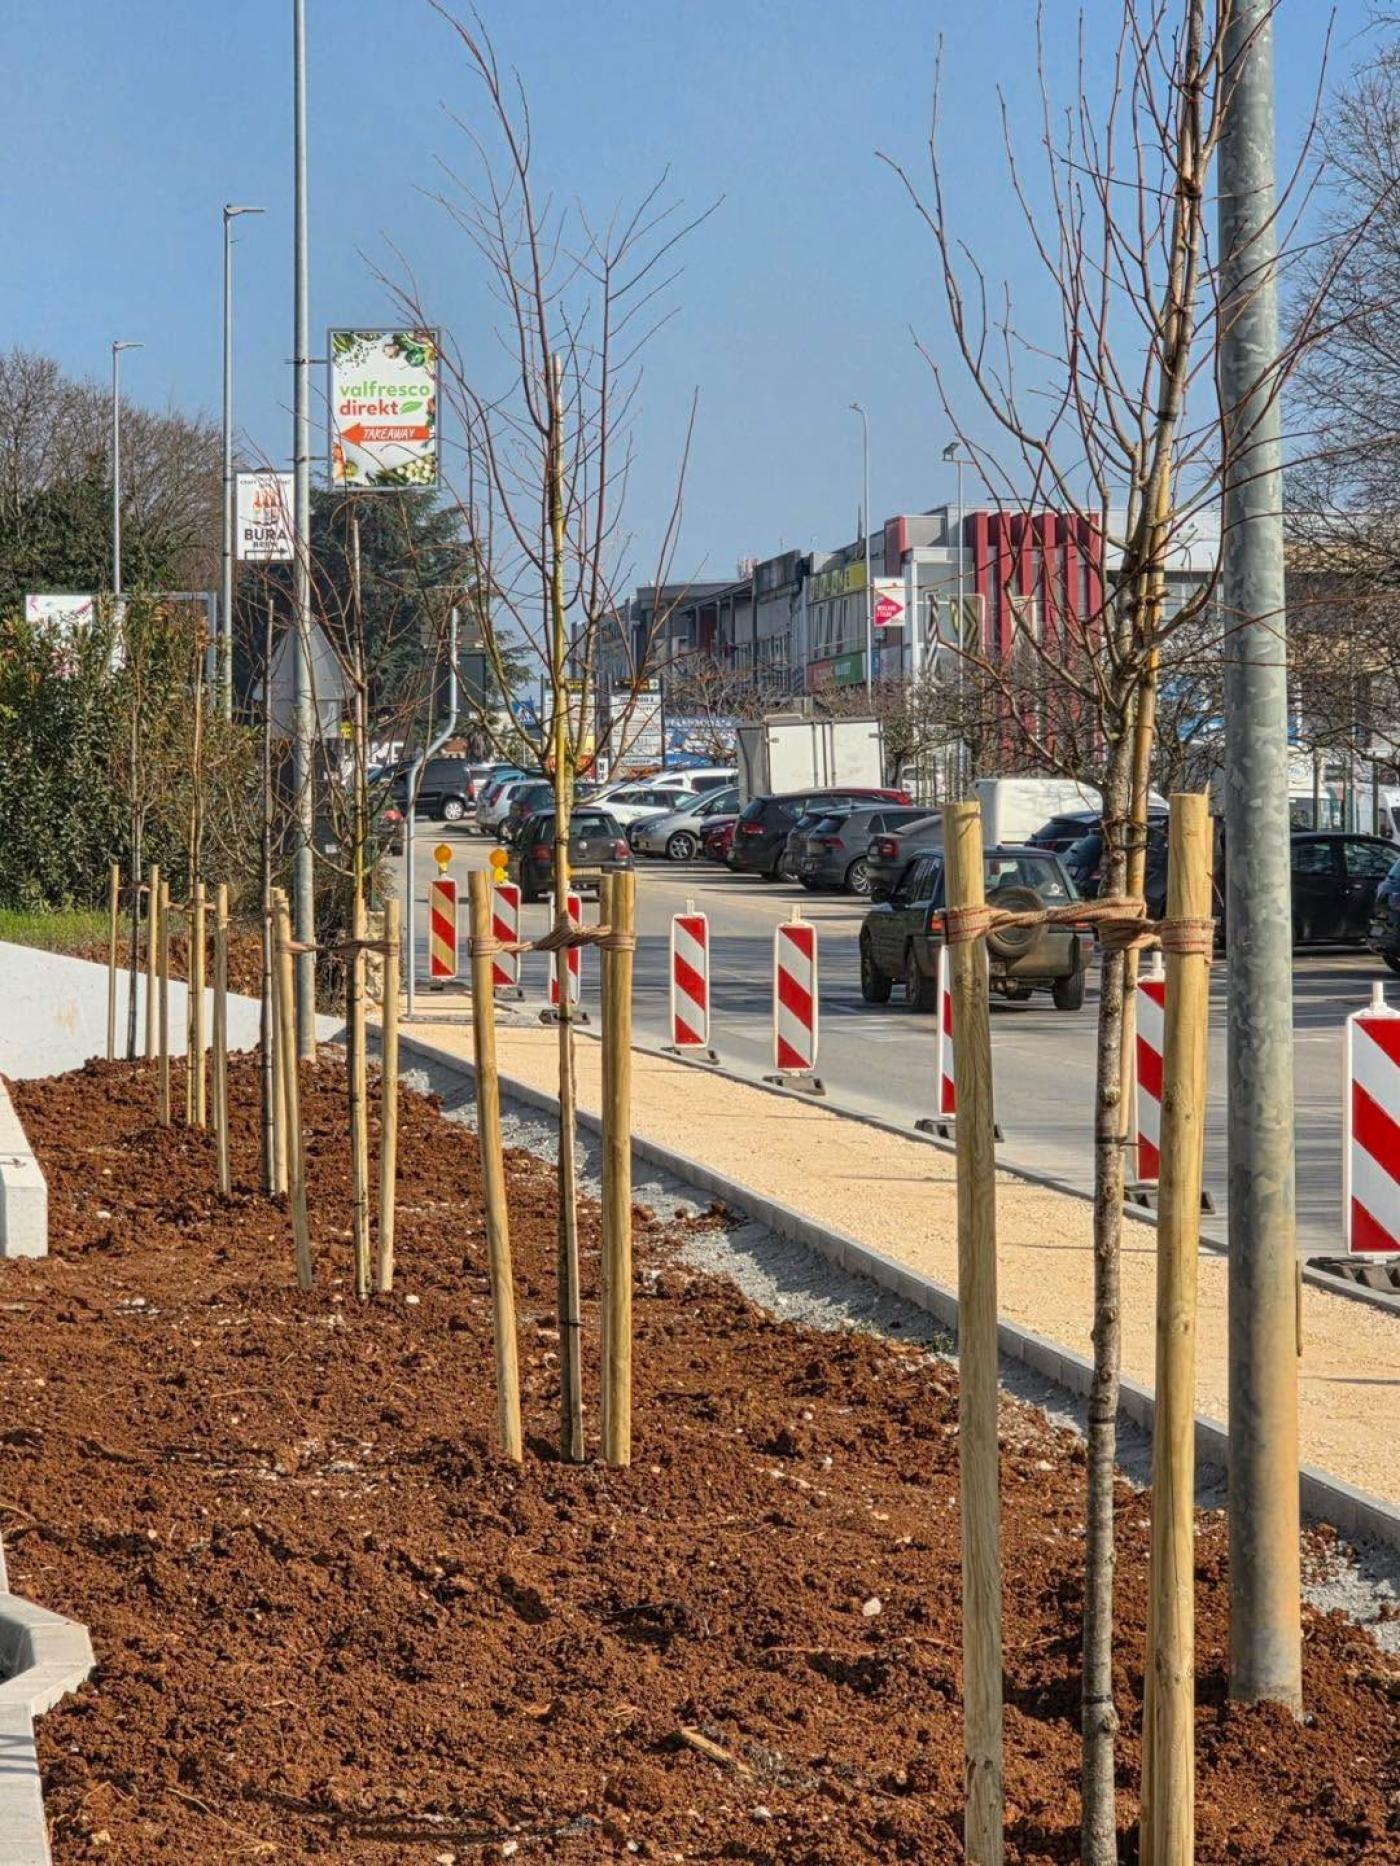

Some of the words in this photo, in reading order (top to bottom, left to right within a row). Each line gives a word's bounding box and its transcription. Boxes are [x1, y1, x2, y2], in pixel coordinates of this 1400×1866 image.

[339, 381, 430, 397] valfresco
[339, 399, 399, 416] direkt
[362, 428, 416, 441] TAKEAWAY
[245, 528, 287, 541] BURA
